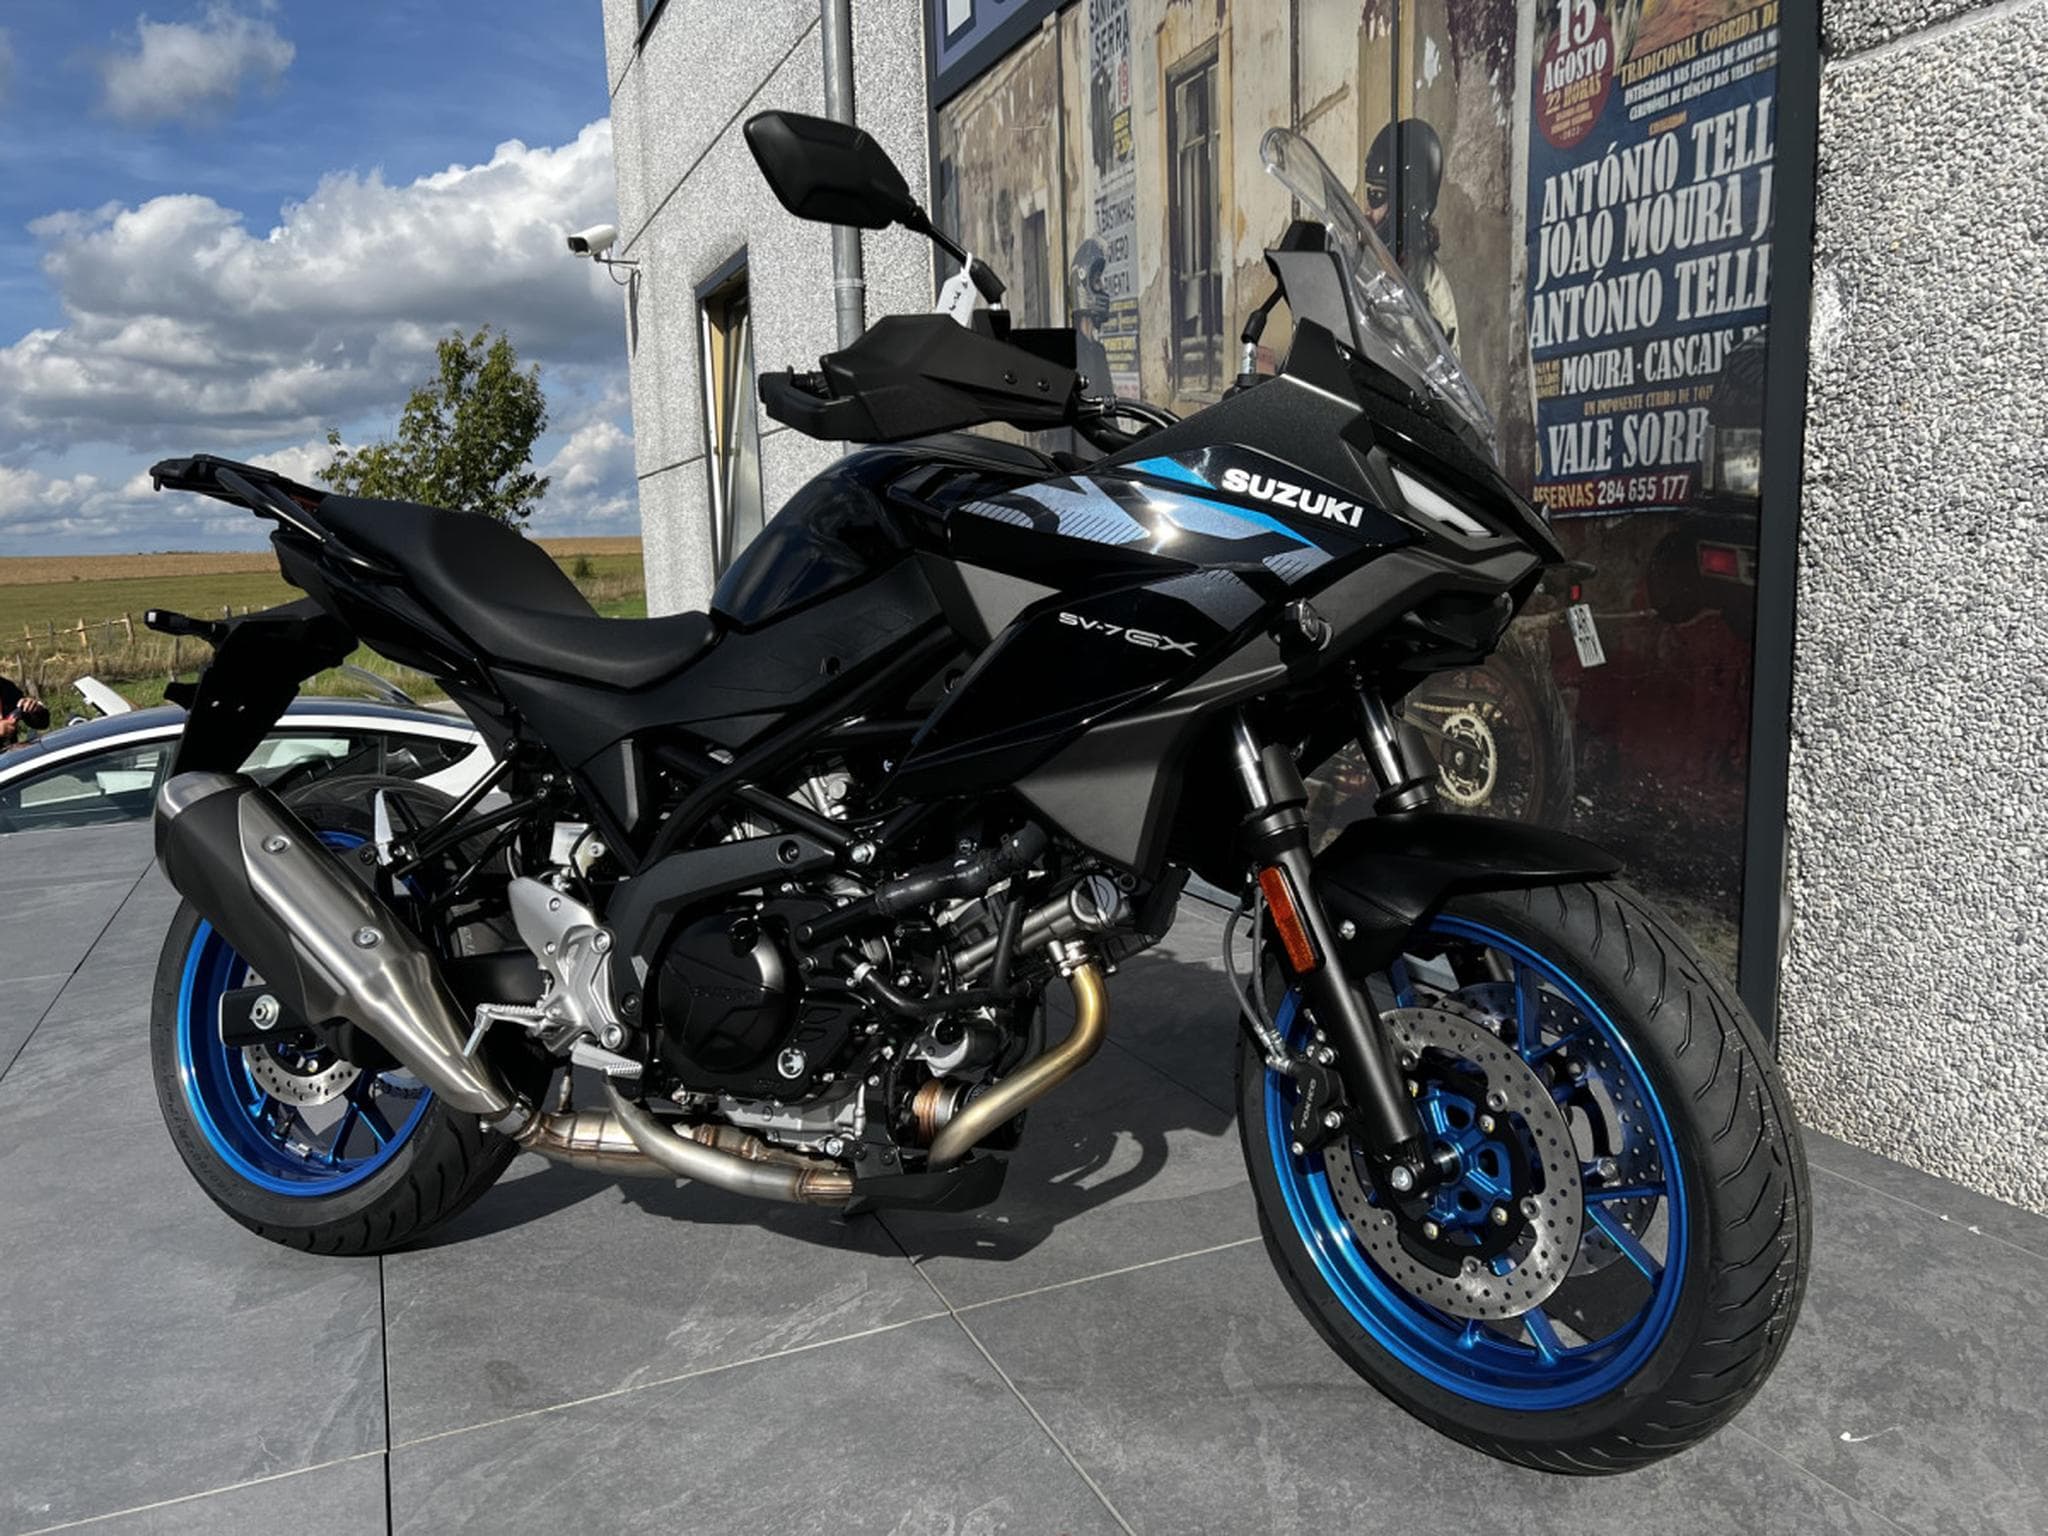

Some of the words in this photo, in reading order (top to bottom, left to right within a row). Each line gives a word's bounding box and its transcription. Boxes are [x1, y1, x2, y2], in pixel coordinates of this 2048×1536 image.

[1556, 0, 1597, 53] 15
[1620, 35, 1698, 88] TRADICIONAL
[1701, 9, 1758, 53] CORRIDA
[1542, 37, 1607, 95] AGOSTO
[1545, 90, 1561, 116] 22
[1563, 73, 1602, 108] HORAS
[1541, 131, 1679, 226] ANTÓNIO
[1622, 174, 1743, 262] MOURA
[1750, 164, 1775, 242] J
[1530, 267, 1663, 349] ANTÓNIO
[1561, 346, 1635, 396] MOURA
[1548, 417, 1614, 477] VALE
[1222, 468, 1364, 528] SUZUKI
[1597, 480, 1625, 505] 284
[1628, 476, 1657, 502] 655
[1662, 475, 1689, 500] 177
